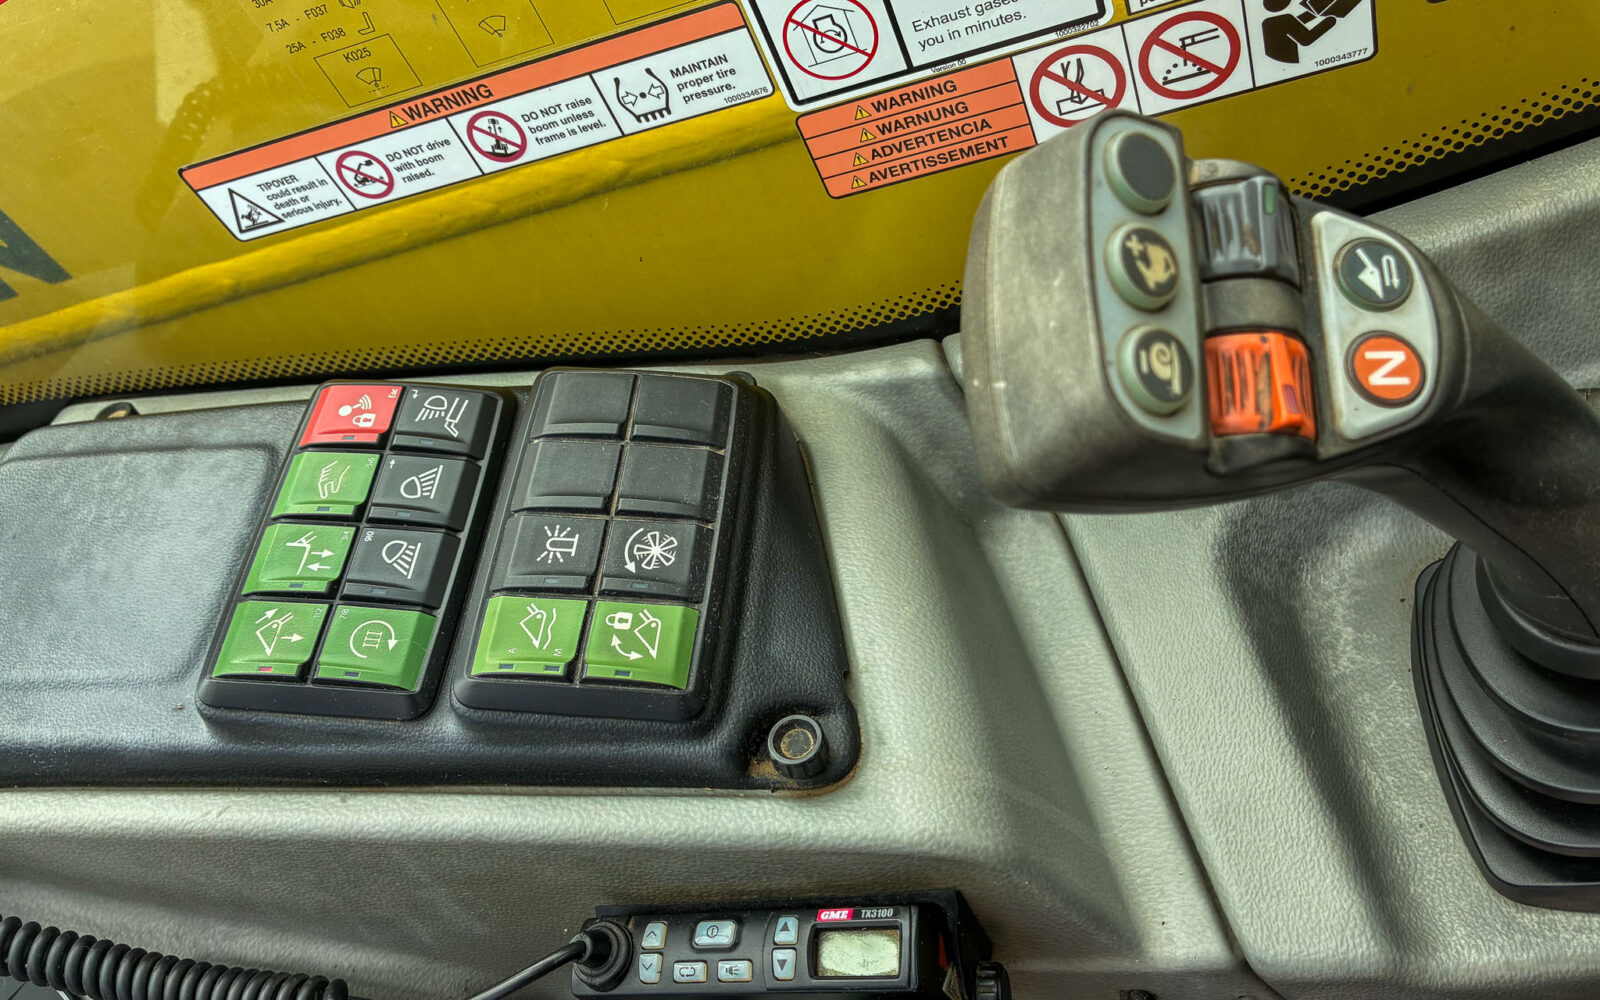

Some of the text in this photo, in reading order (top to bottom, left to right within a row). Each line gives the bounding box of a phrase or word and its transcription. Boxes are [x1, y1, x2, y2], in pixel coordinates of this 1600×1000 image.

[266, 19, 291, 33] 7,5A
[304, 4, 328, 19] F037
[912, 0, 1018, 33] Exhaust gase
[286, 41, 307, 54] 25A
[321, 27, 346, 42] F038
[918, 11, 1027, 52] you in minutes.
[343, 47, 371, 63] K025
[669, 54, 729, 79] MAINTAIN
[1315, 48, 1368, 67] 1000343777
[677, 68, 736, 92] proper tire
[401, 83, 494, 121] WARNING
[683, 83, 736, 104] pressure.
[870, 80, 958, 113] WARNING
[521, 97, 592, 123] DO NOT raise
[528, 110, 595, 134] boom unless
[876, 101, 969, 136] WARNUNG
[535, 119, 607, 146] frame is level.
[871, 118, 992, 161] ADVERTENCIA
[385, 138, 451, 163] DO NOT drive
[394, 153, 445, 173] with boom
[869, 136, 1009, 183] AVERTISSEMENT
[256, 174, 299, 192] TIPOVER
[402, 169, 435, 183] raised.
[266, 178, 329, 201] could result in
[274, 195, 311, 210] death or
[281, 198, 343, 219] serious injury.
[820, 908, 894, 920] GME TX3100
